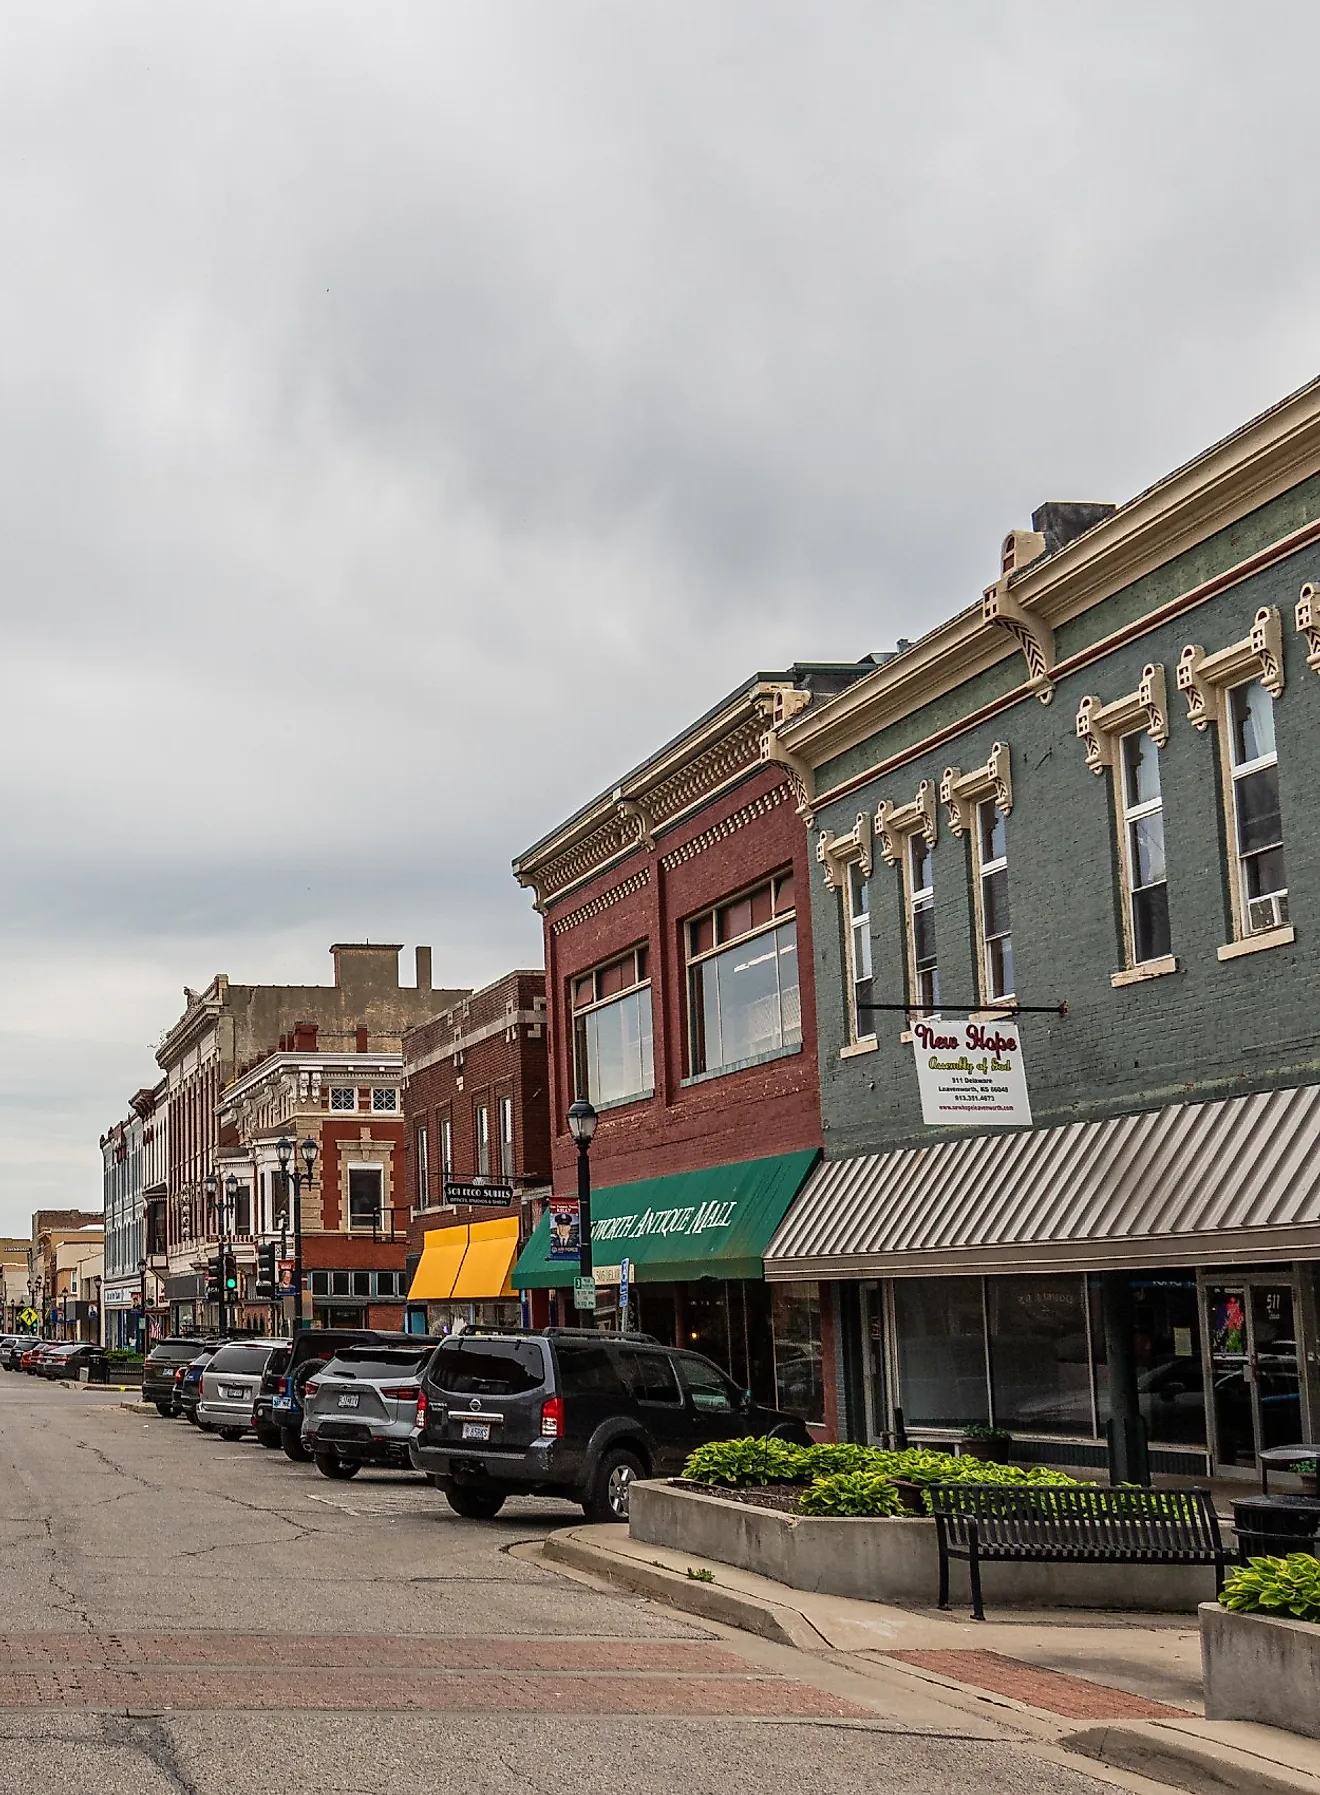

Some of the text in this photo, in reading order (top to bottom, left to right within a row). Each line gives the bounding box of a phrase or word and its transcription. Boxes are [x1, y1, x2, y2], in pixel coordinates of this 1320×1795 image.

[914, 1023, 1018, 1061] New Hope
[928, 1055, 1012, 1075] Assembly of God
[628, 1207, 696, 1238] ANTIQUE
[684, 1200, 738, 1235] MALL
